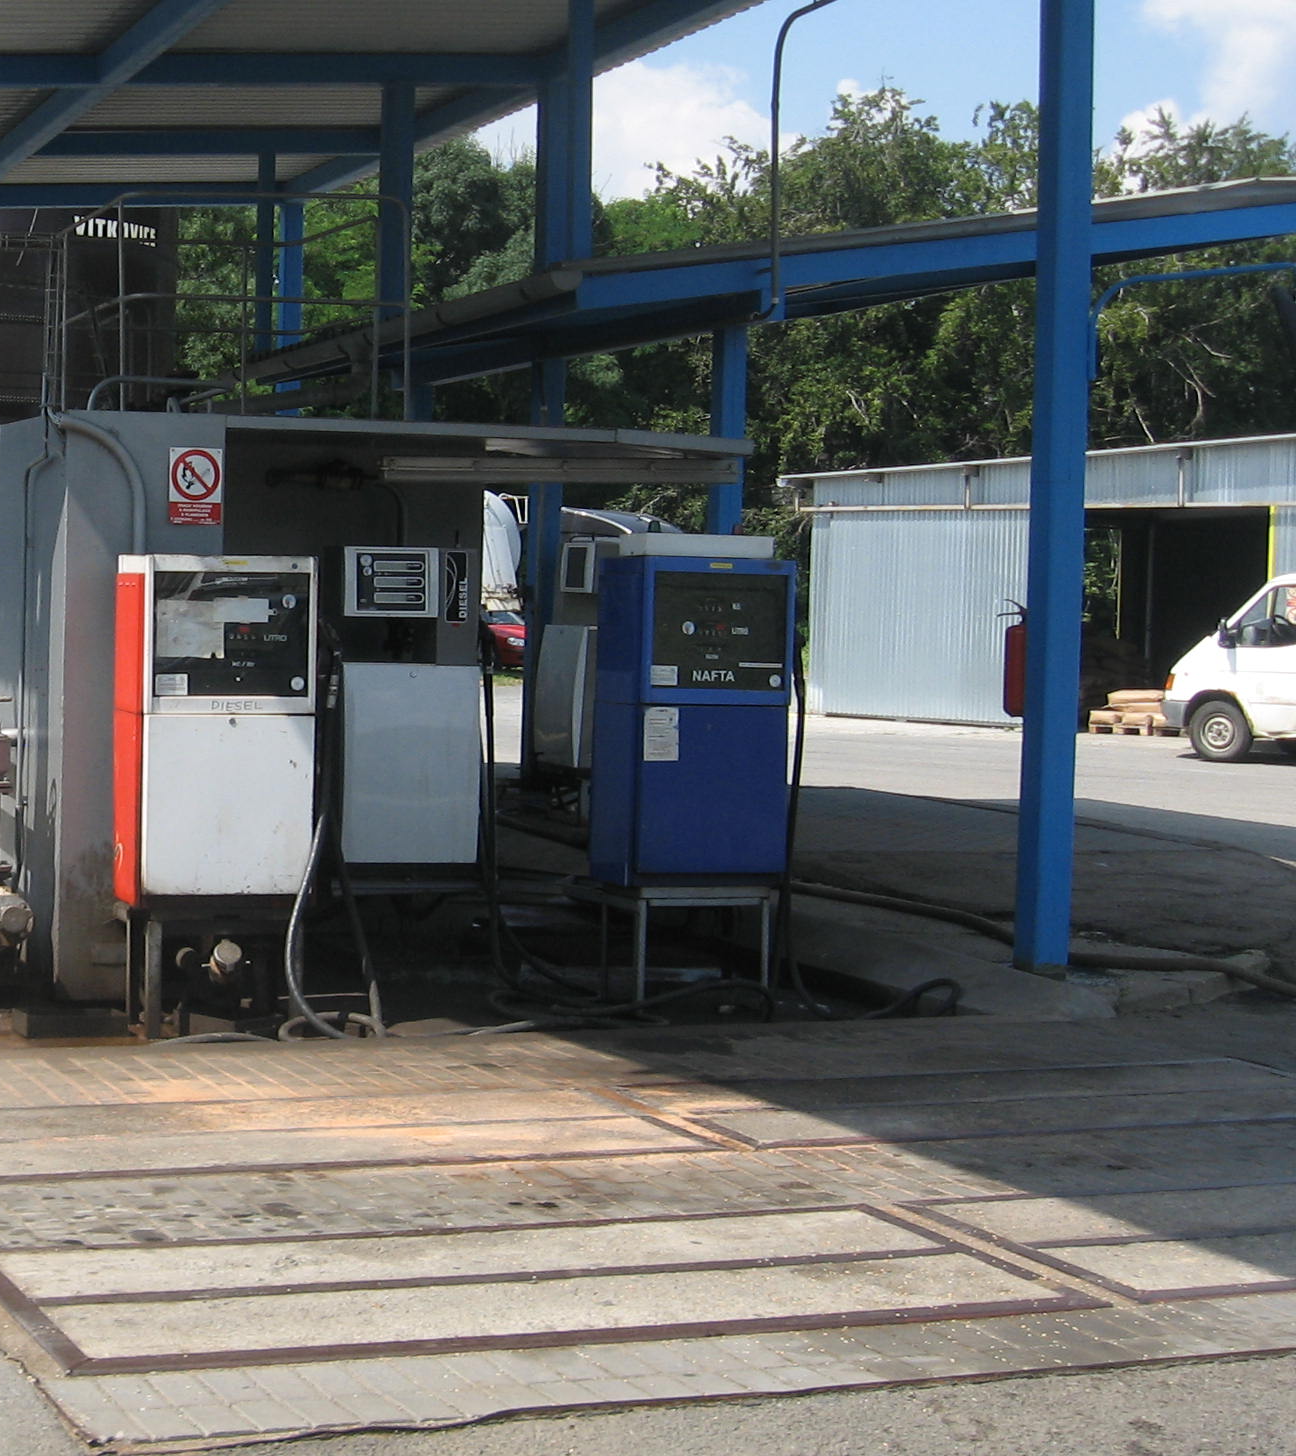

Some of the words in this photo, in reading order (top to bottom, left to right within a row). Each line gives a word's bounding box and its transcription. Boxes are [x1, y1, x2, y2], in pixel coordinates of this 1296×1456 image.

[459, 577, 468, 619] DIESEL
[692, 670, 735, 682] NAFTA
[211, 700, 264, 711] DIESEL
